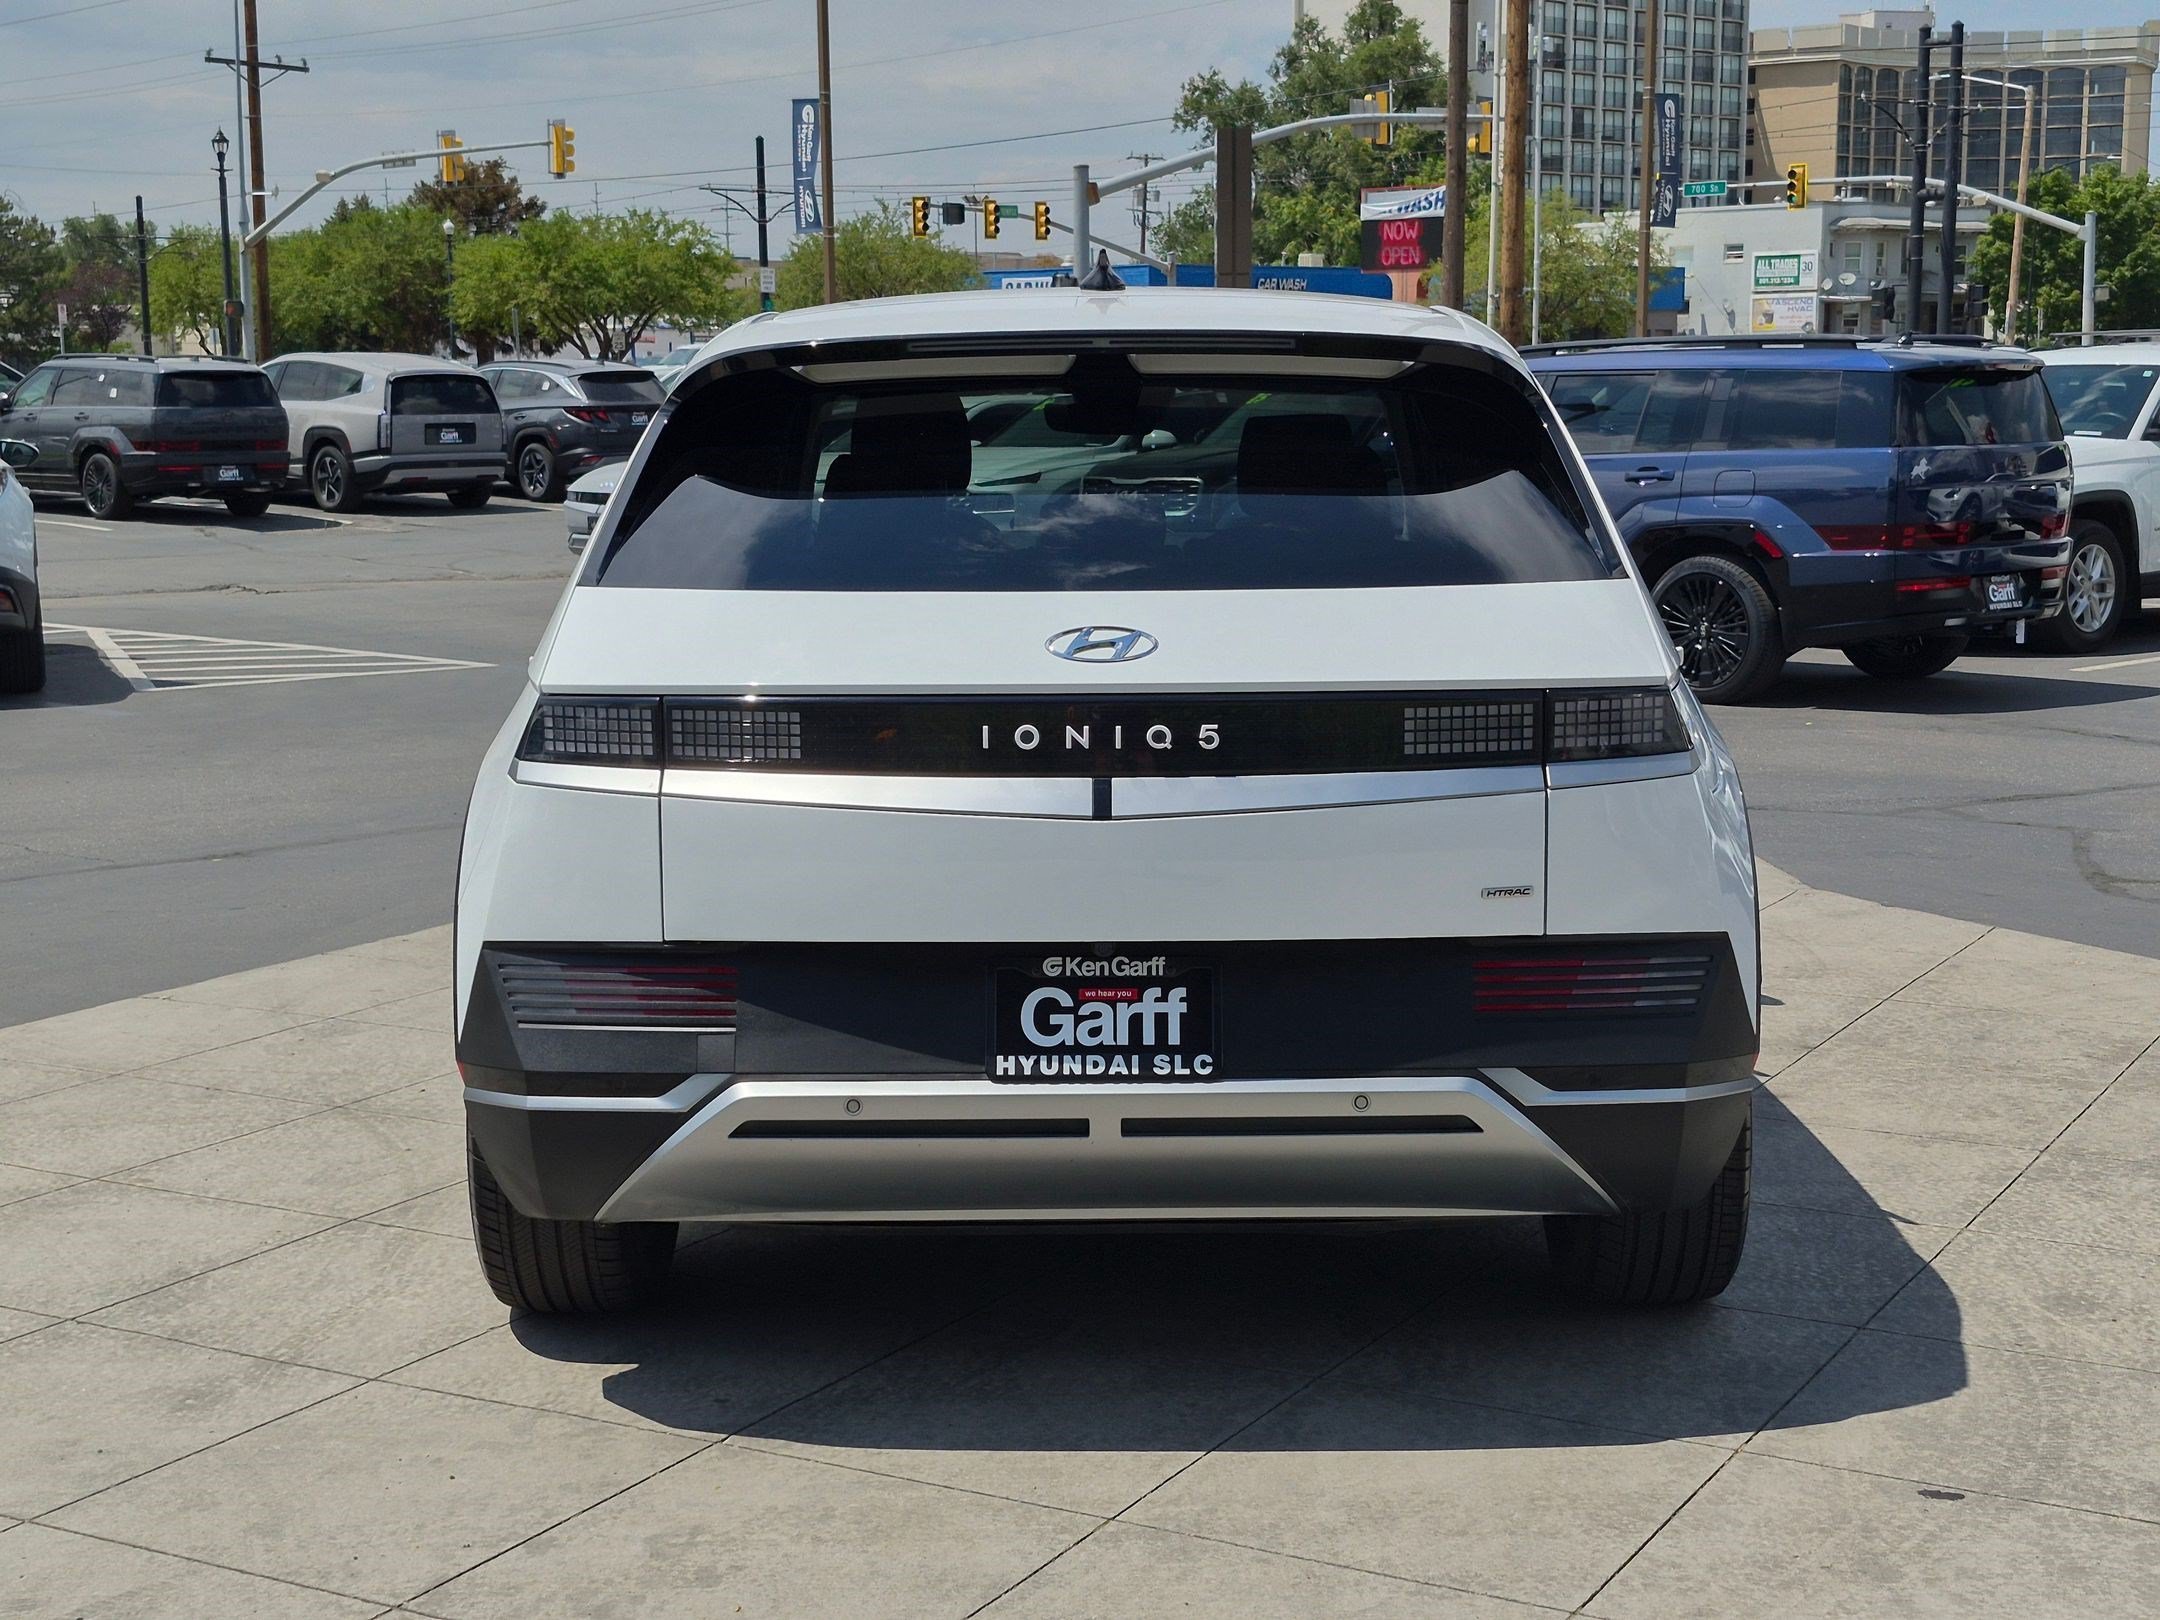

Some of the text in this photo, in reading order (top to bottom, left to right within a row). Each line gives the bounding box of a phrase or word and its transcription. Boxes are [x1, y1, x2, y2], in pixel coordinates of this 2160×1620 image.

[1691, 185, 1706, 194] 700
[1383, 221, 1419, 240] NOW
[1381, 246, 1421, 266] OPEN
[1756, 259, 1770, 269] ALL
[1802, 261, 1813, 272] 30
[1257, 278, 1308, 290] CAR WASH
[1787, 304, 1813, 312] HVAC
[1989, 583, 2015, 602] Garff
[982, 724, 1220, 750] IONIQ 5
[1486, 887, 1531, 897] HTRAC
[1098, 989, 1115, 997] hear
[1020, 986, 1188, 1047] Garff
[996, 1055, 1214, 1076] HYUNDAI SLC
